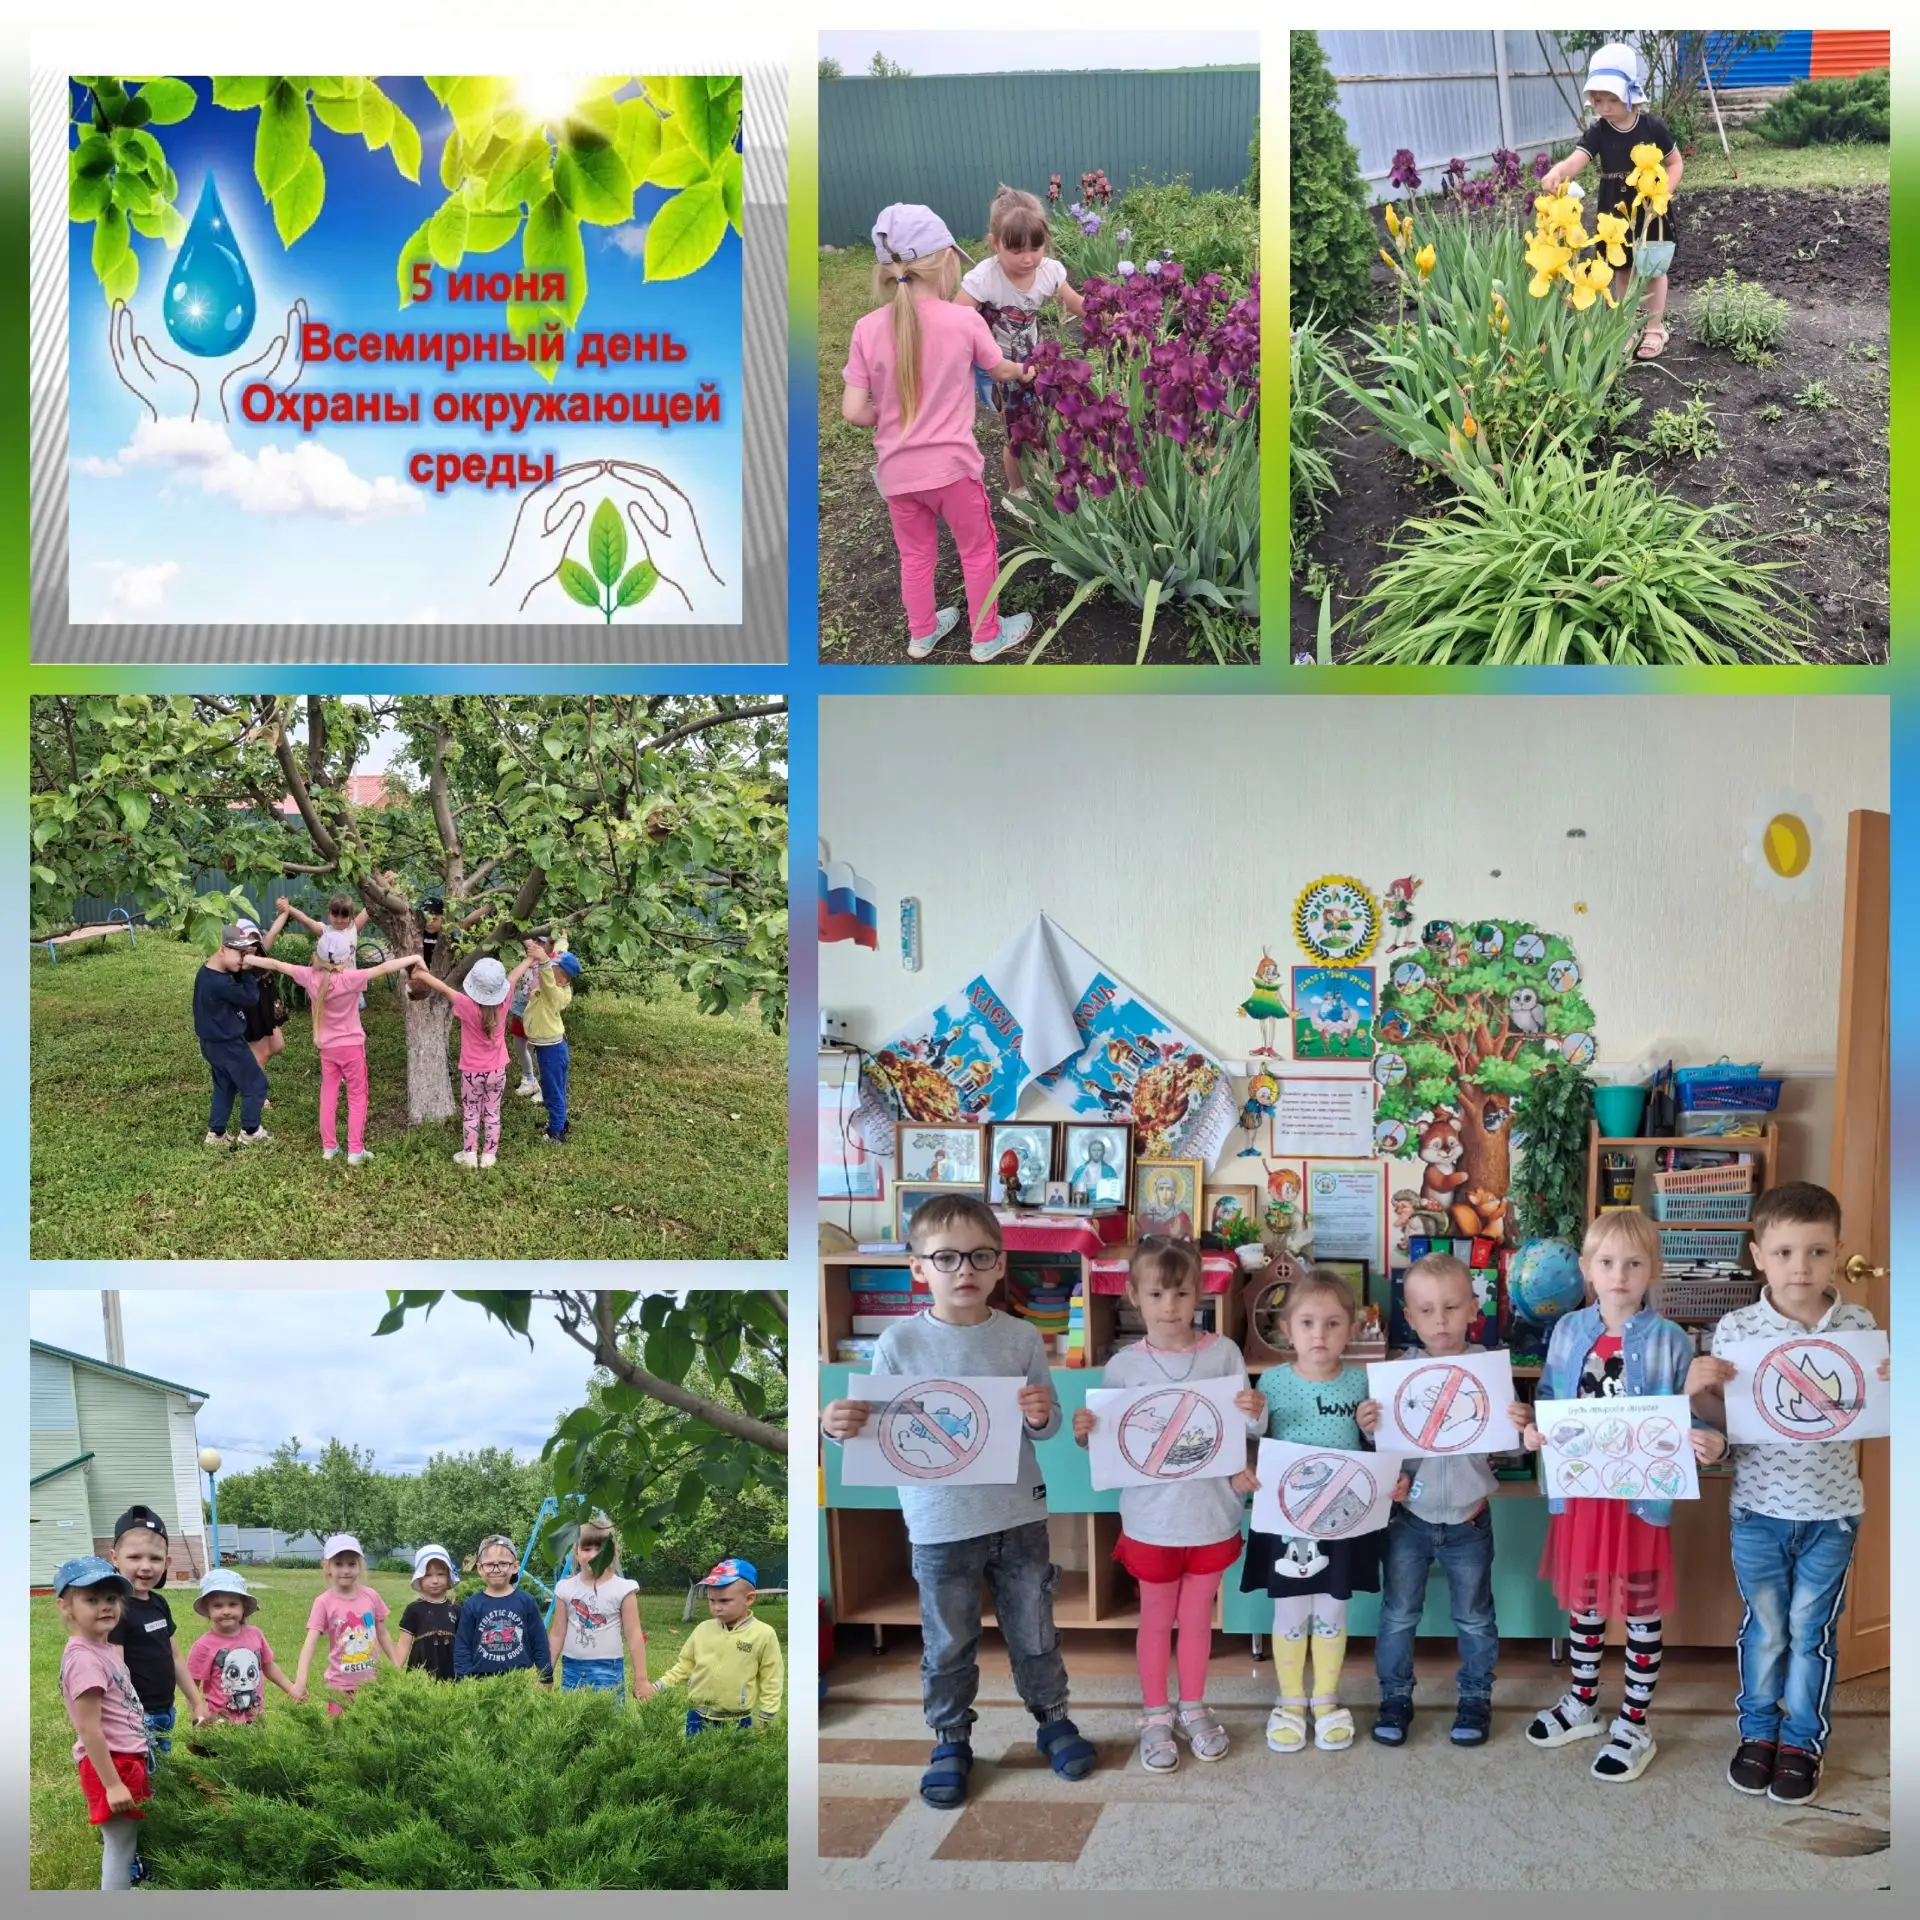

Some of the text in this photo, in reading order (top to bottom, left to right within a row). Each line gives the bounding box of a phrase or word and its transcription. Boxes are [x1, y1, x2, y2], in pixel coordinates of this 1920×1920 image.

[968, 985, 1017, 1036] ХЛЕБ
[1073, 985, 1116, 1029] СОЛЬ
[478, 1609, 507, 1632] ATHLETIC
